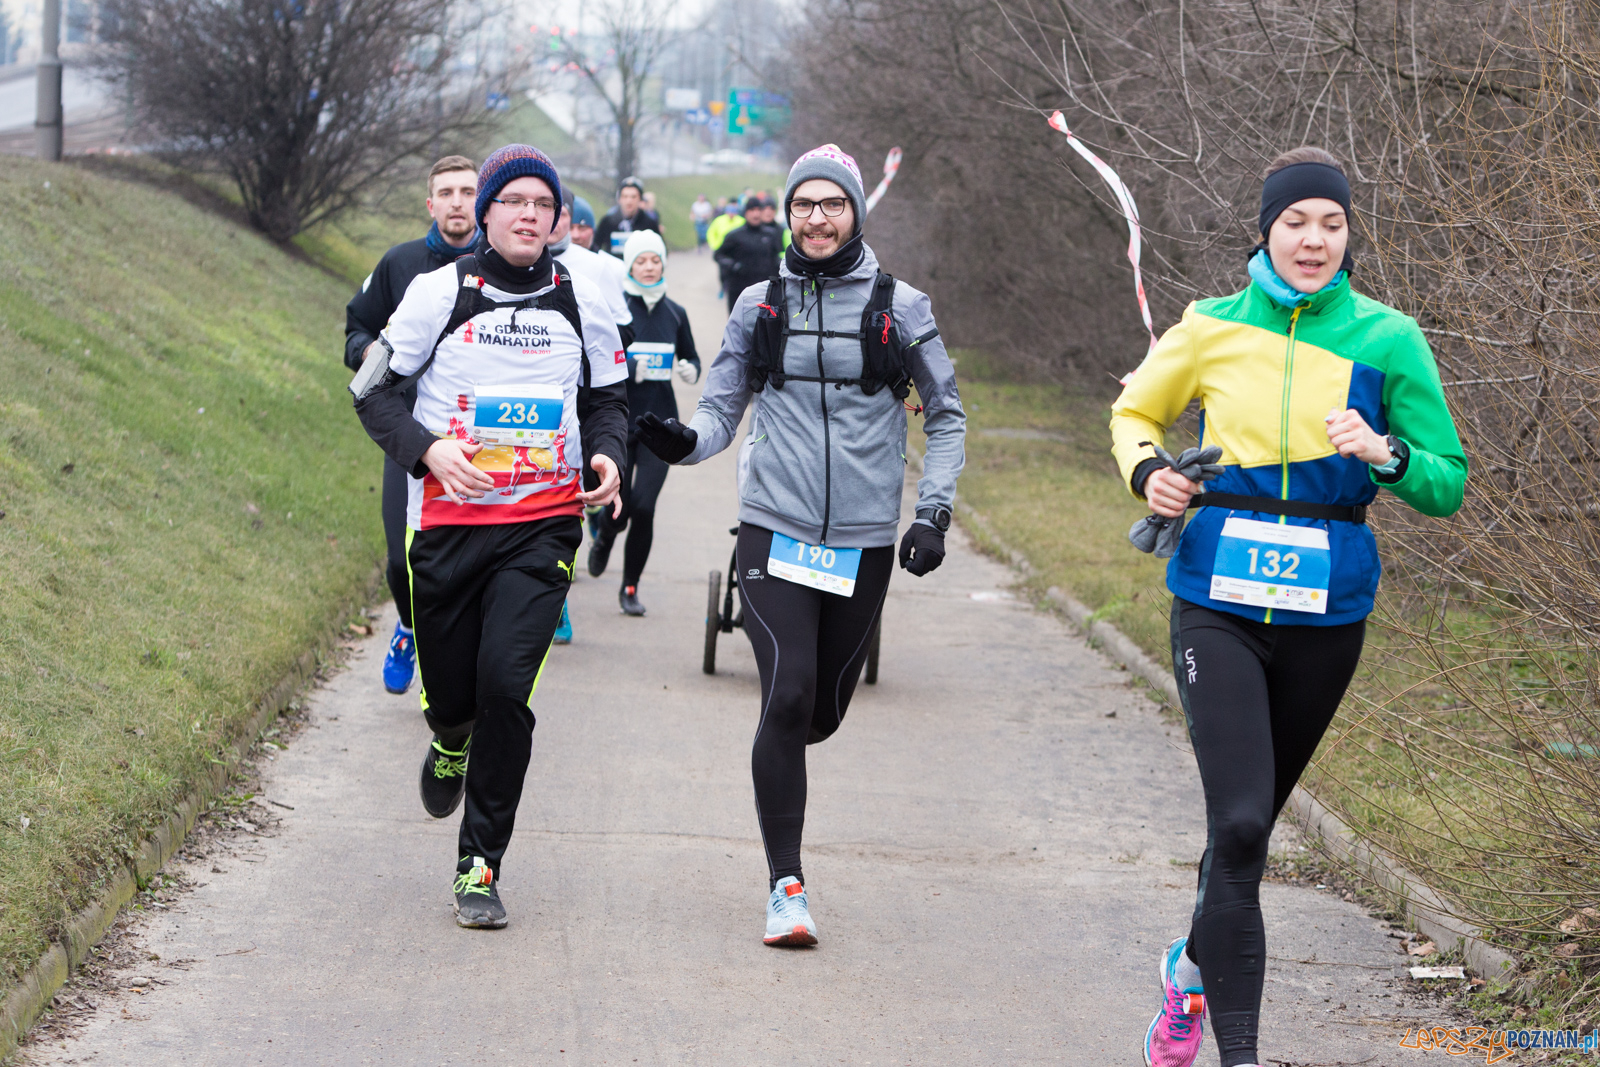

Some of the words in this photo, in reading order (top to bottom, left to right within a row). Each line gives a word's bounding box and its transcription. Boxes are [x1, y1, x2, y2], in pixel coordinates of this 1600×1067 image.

[478, 333, 551, 347] MARATON
[495, 322, 549, 336] GDAŃSK
[497, 402, 539, 424] 236
[797, 542, 836, 568] 190
[1247, 547, 1300, 580] 132
